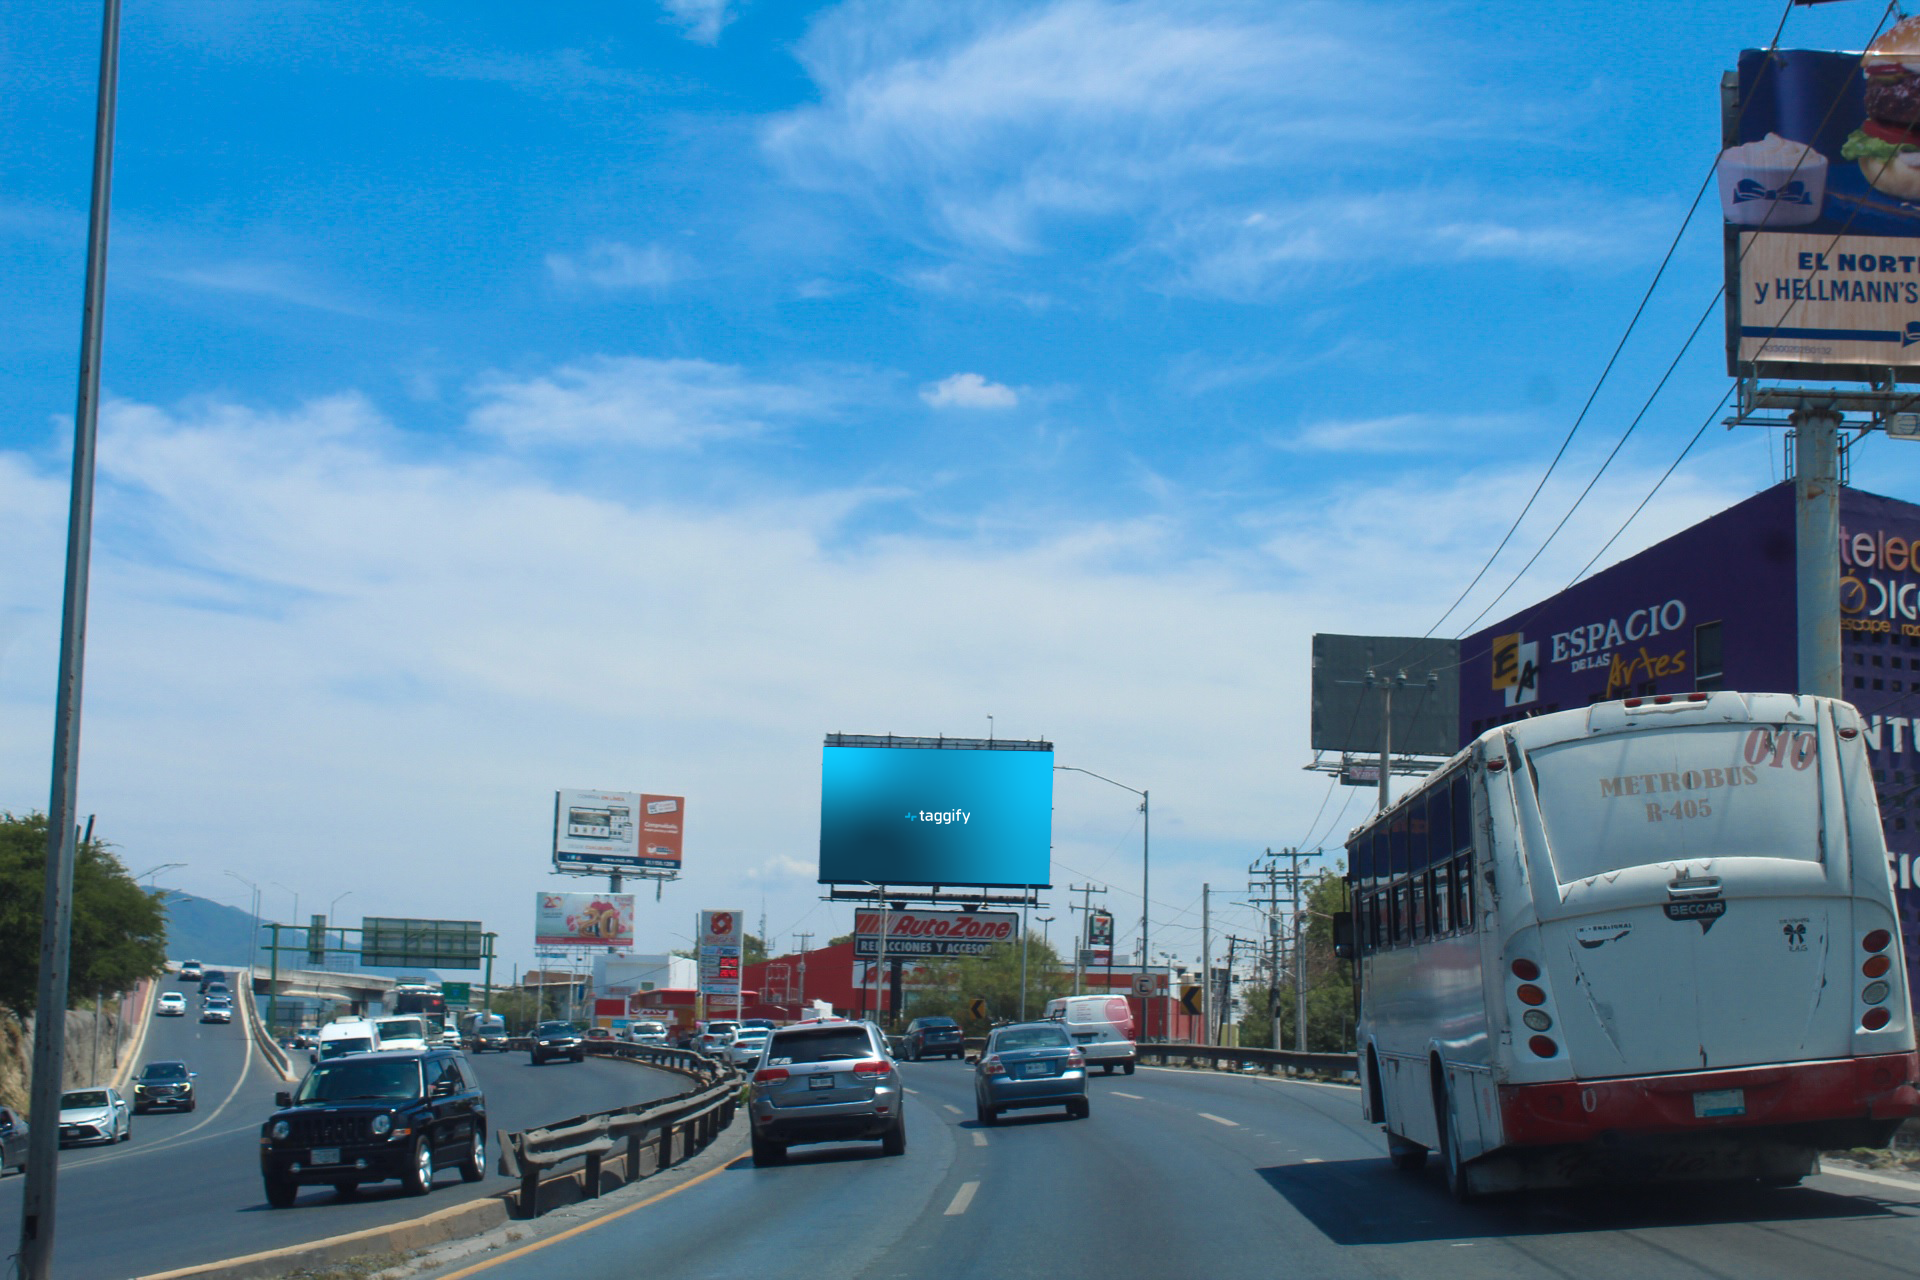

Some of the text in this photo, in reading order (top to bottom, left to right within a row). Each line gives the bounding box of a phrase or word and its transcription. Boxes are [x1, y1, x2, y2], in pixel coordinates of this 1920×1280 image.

[1798, 252, 1920, 274] EL NORT
[1754, 278, 1919, 305] y HELLMANN'S
[1551, 599, 1687, 663] ESPACIO
[1571, 647, 1687, 699] DE LAS Artes
[1744, 726, 1817, 772] 010
[1600, 765, 1758, 799] METROBUS
[919, 808, 971, 825] taggify
[1646, 799, 1712, 823] R-405
[1669, 901, 1724, 916] BECCAR
[893, 914, 1012, 939] AutoZone
[936, 942, 943, 953] Y
